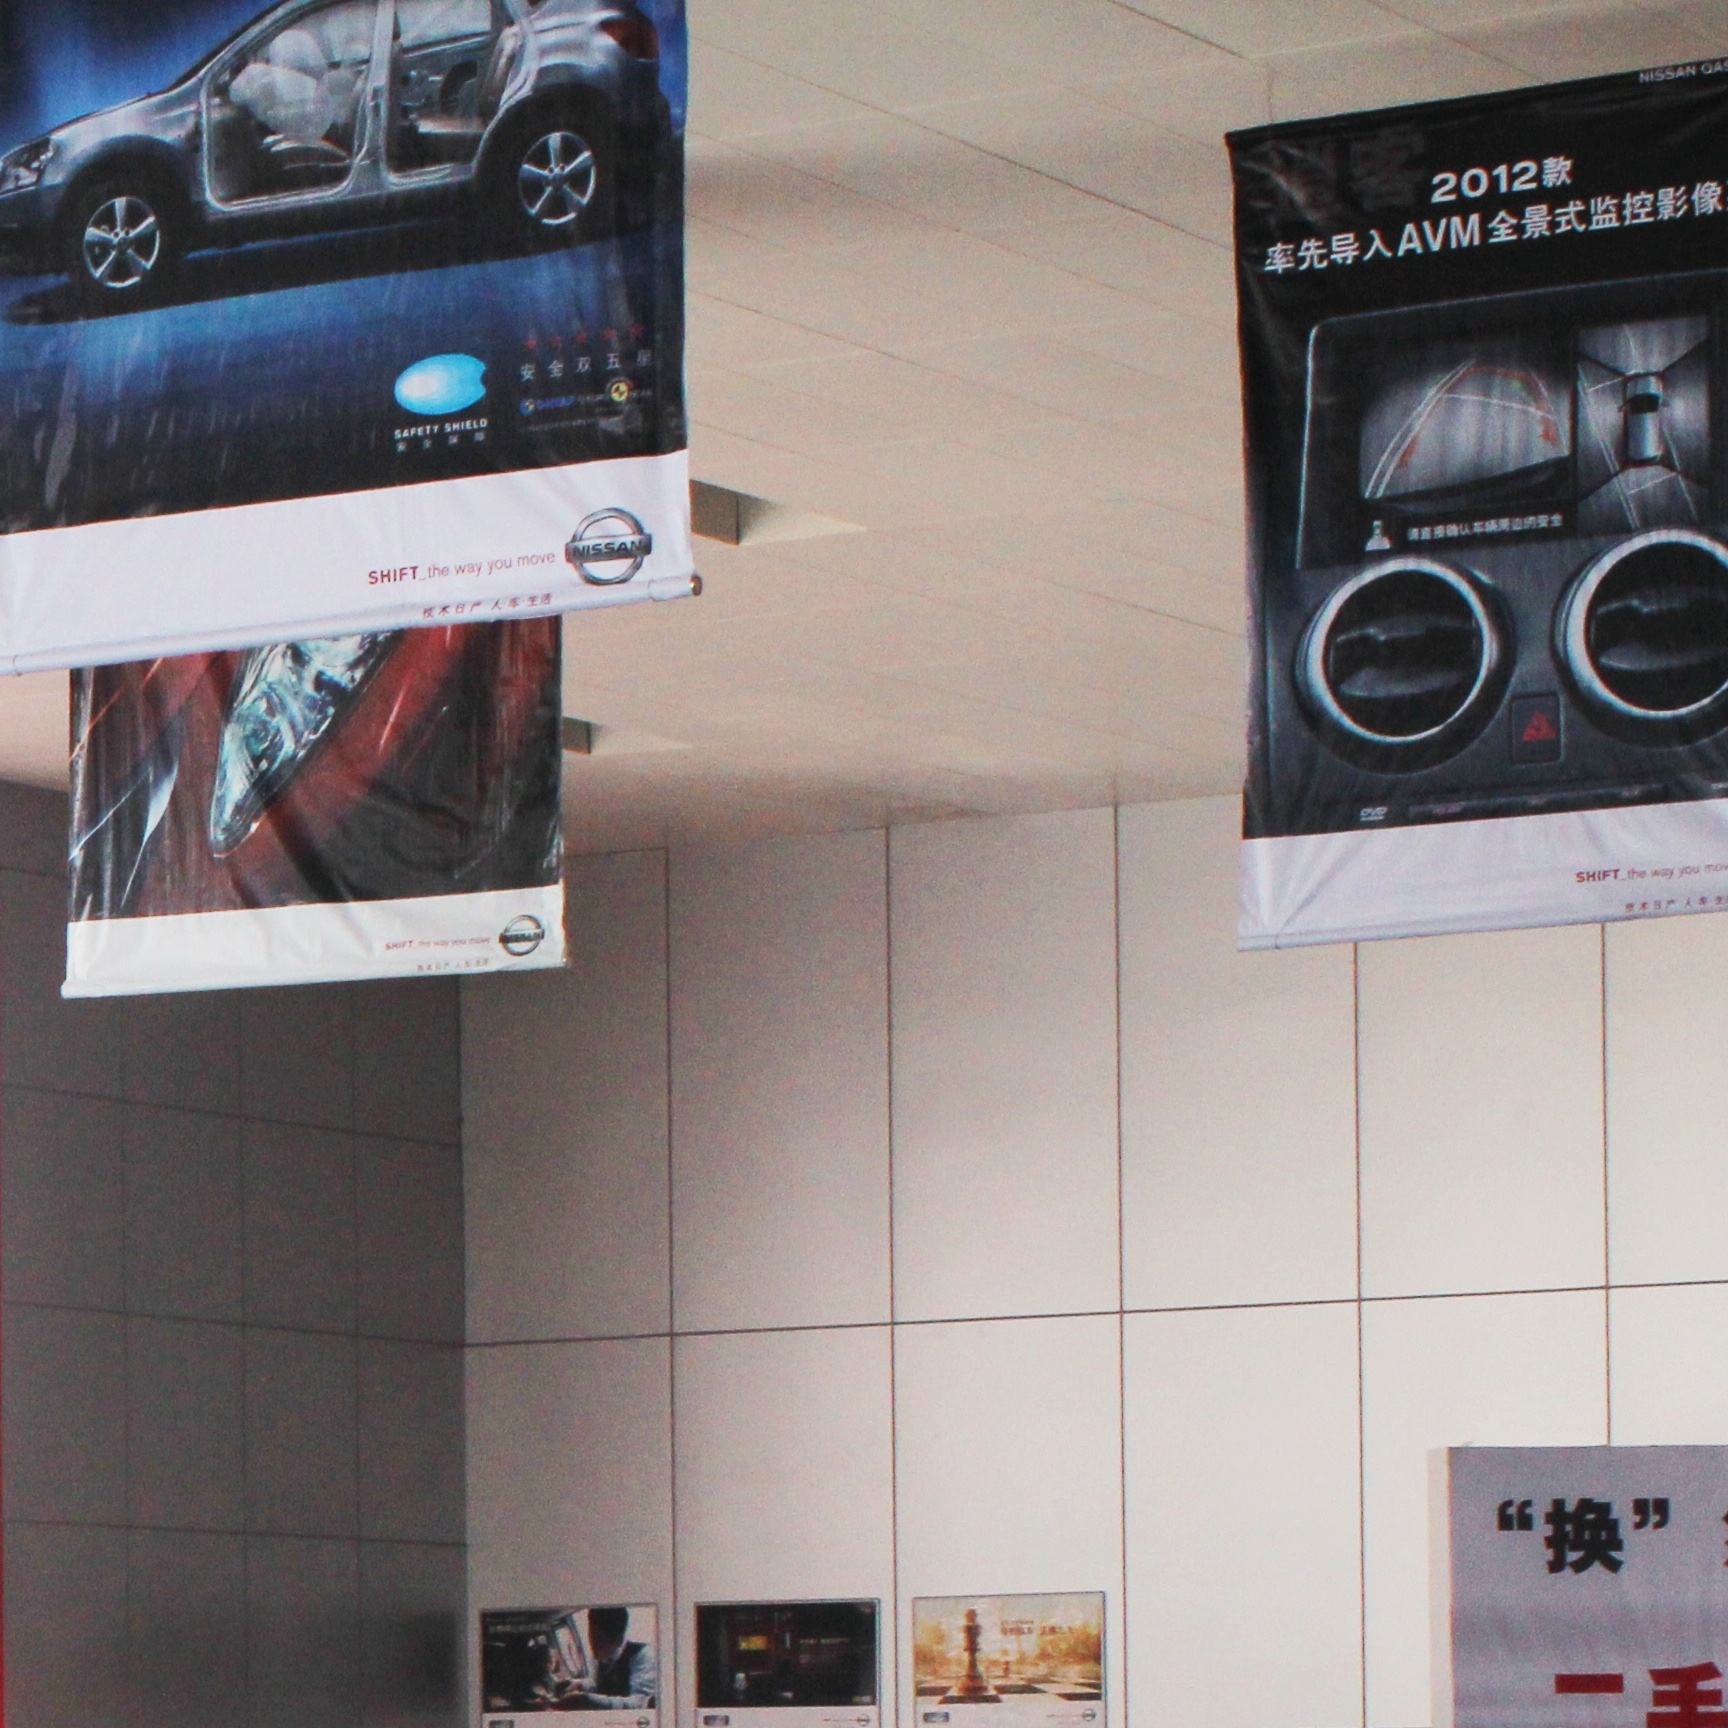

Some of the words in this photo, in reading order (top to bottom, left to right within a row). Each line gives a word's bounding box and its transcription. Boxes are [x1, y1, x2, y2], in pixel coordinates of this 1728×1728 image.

[1639, 65, 1697, 83] NISSAN
[1431, 156, 1574, 203] 2012款
[394, 423, 439, 440] SAFETY
[444, 418, 488, 433] SHIELD
[575, 540, 642, 557] NISSAN
[454, 562, 482, 578] way
[488, 557, 512, 576] you
[516, 550, 556, 567] move
[1650, 867, 1675, 880] way
[1679, 865, 1700, 878] you
